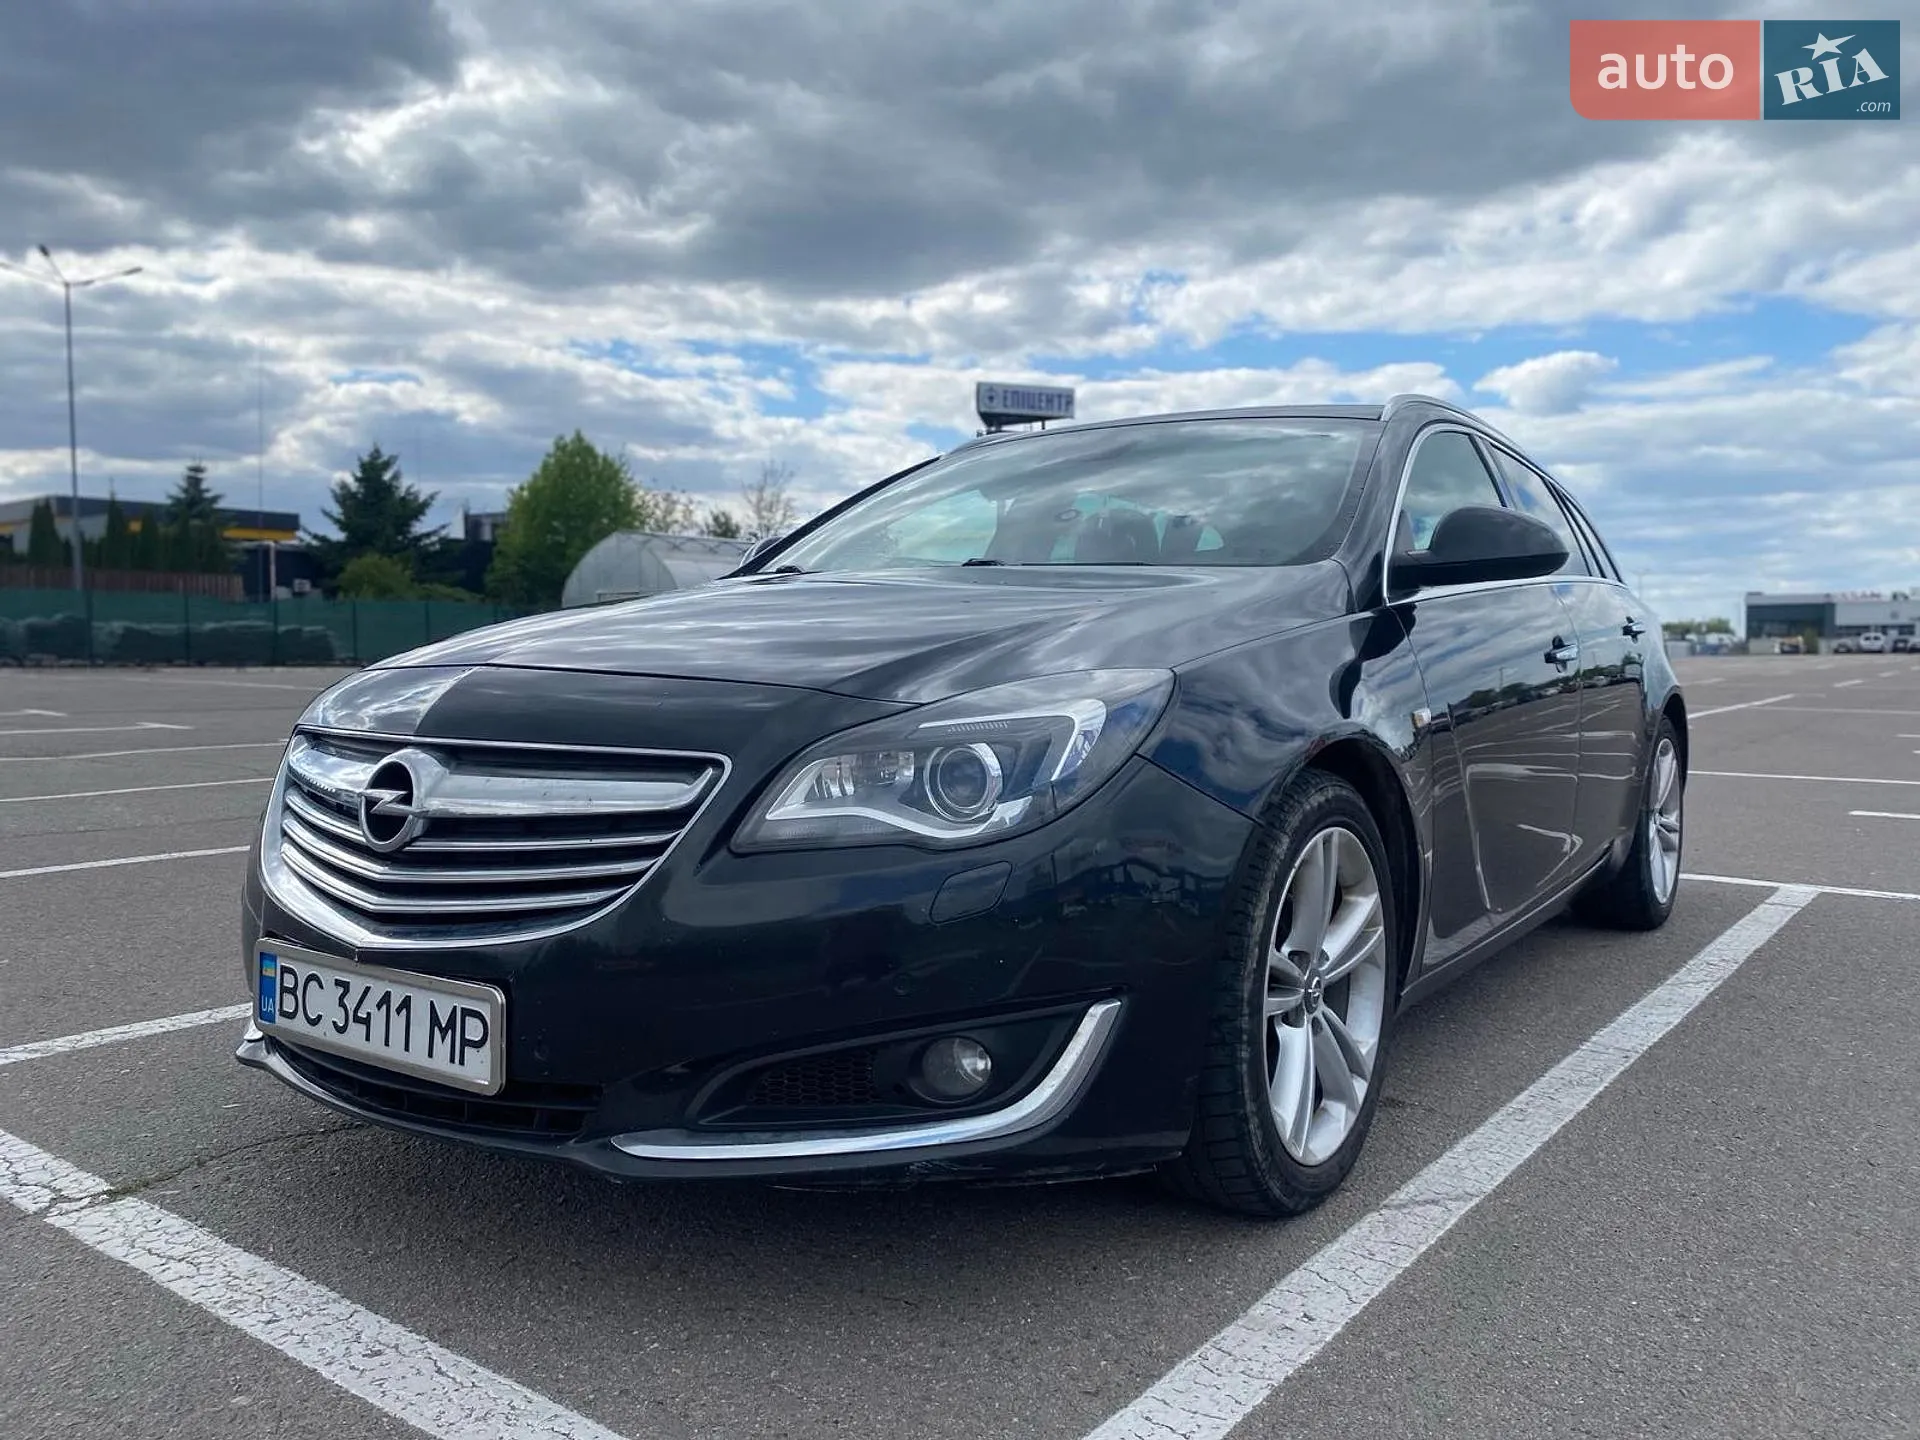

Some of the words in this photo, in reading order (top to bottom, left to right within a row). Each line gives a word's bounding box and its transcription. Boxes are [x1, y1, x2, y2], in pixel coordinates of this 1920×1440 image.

[260, 997, 275, 1012] UA
[279, 965, 325, 1027] BC
[331, 978, 412, 1053] 3411
[428, 999, 489, 1067] MP
